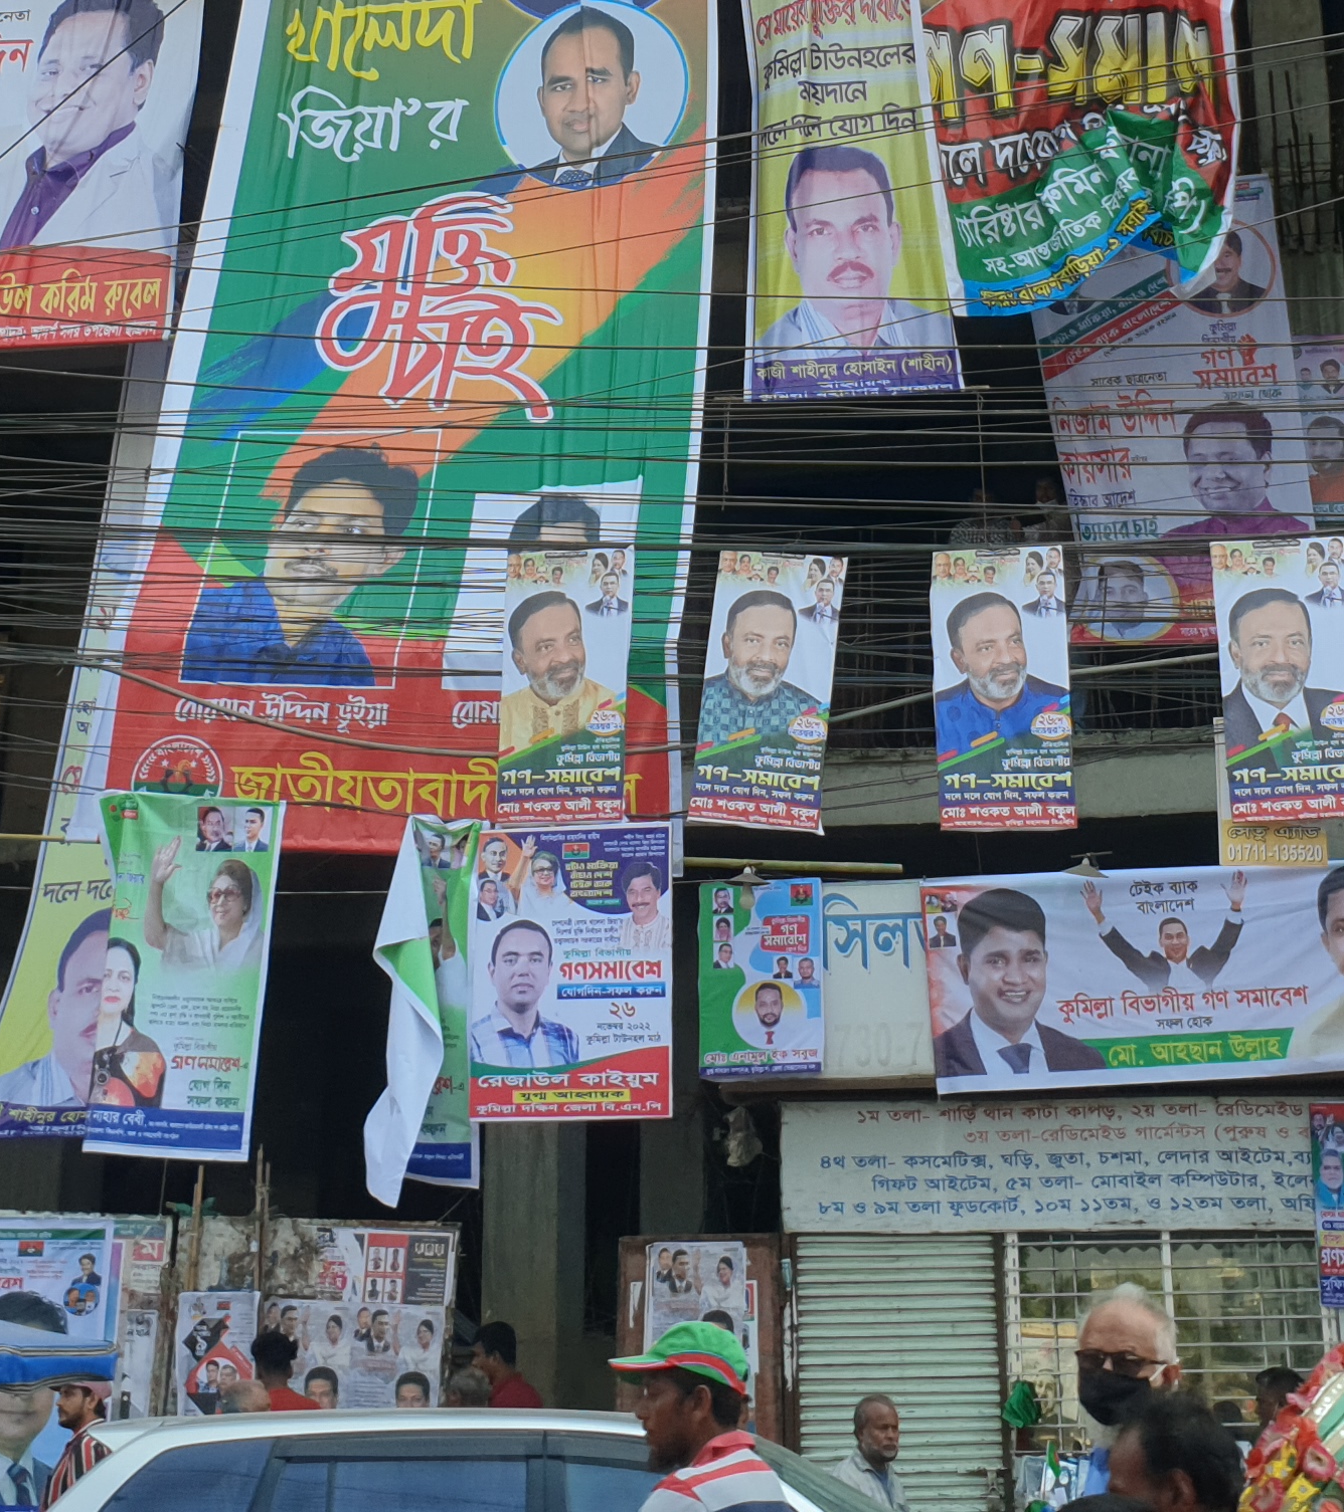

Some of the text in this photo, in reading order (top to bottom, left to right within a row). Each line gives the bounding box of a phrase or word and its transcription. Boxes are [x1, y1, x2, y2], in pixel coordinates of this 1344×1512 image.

[501, 766, 622, 786] গণ-সমাবেশ
[1226, 844, 1323, 864] 01711-135520
[559, 960, 663, 981] গণসমাবেশ
[1056, 982, 1310, 1023] কুমিল্লা বিভাগীয় গণ সমাবেশ
[478, 1071, 572, 1089] রেজাউল
